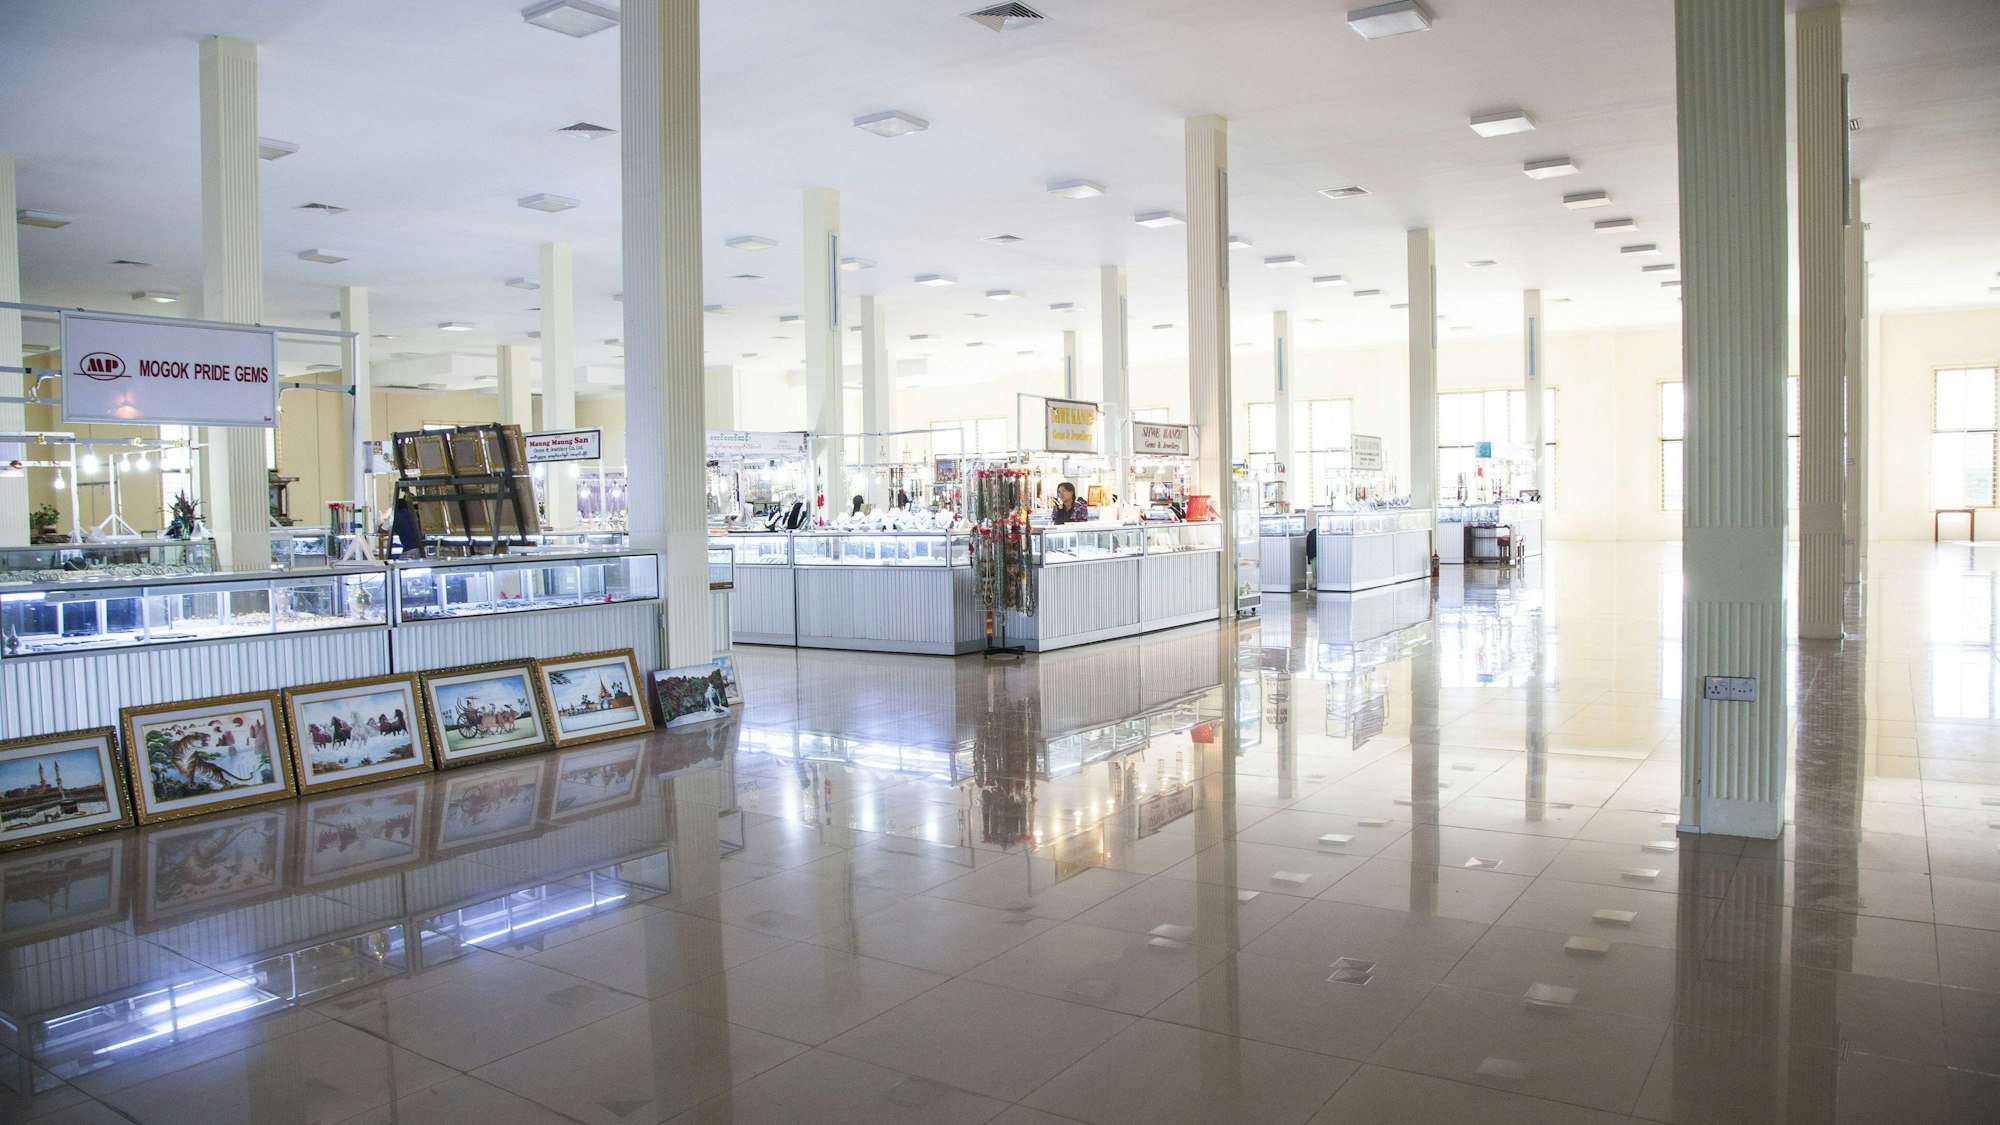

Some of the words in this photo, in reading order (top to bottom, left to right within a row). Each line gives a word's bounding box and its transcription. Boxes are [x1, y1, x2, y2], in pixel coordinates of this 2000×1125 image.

[87, 358, 119, 373] MP
[139, 359, 190, 380] MOGOK
[194, 363, 230, 382] PRIDE
[234, 366, 269, 383] GEMS
[1142, 427, 1160, 438] SHWE
[1144, 440, 1156, 448] Gems
